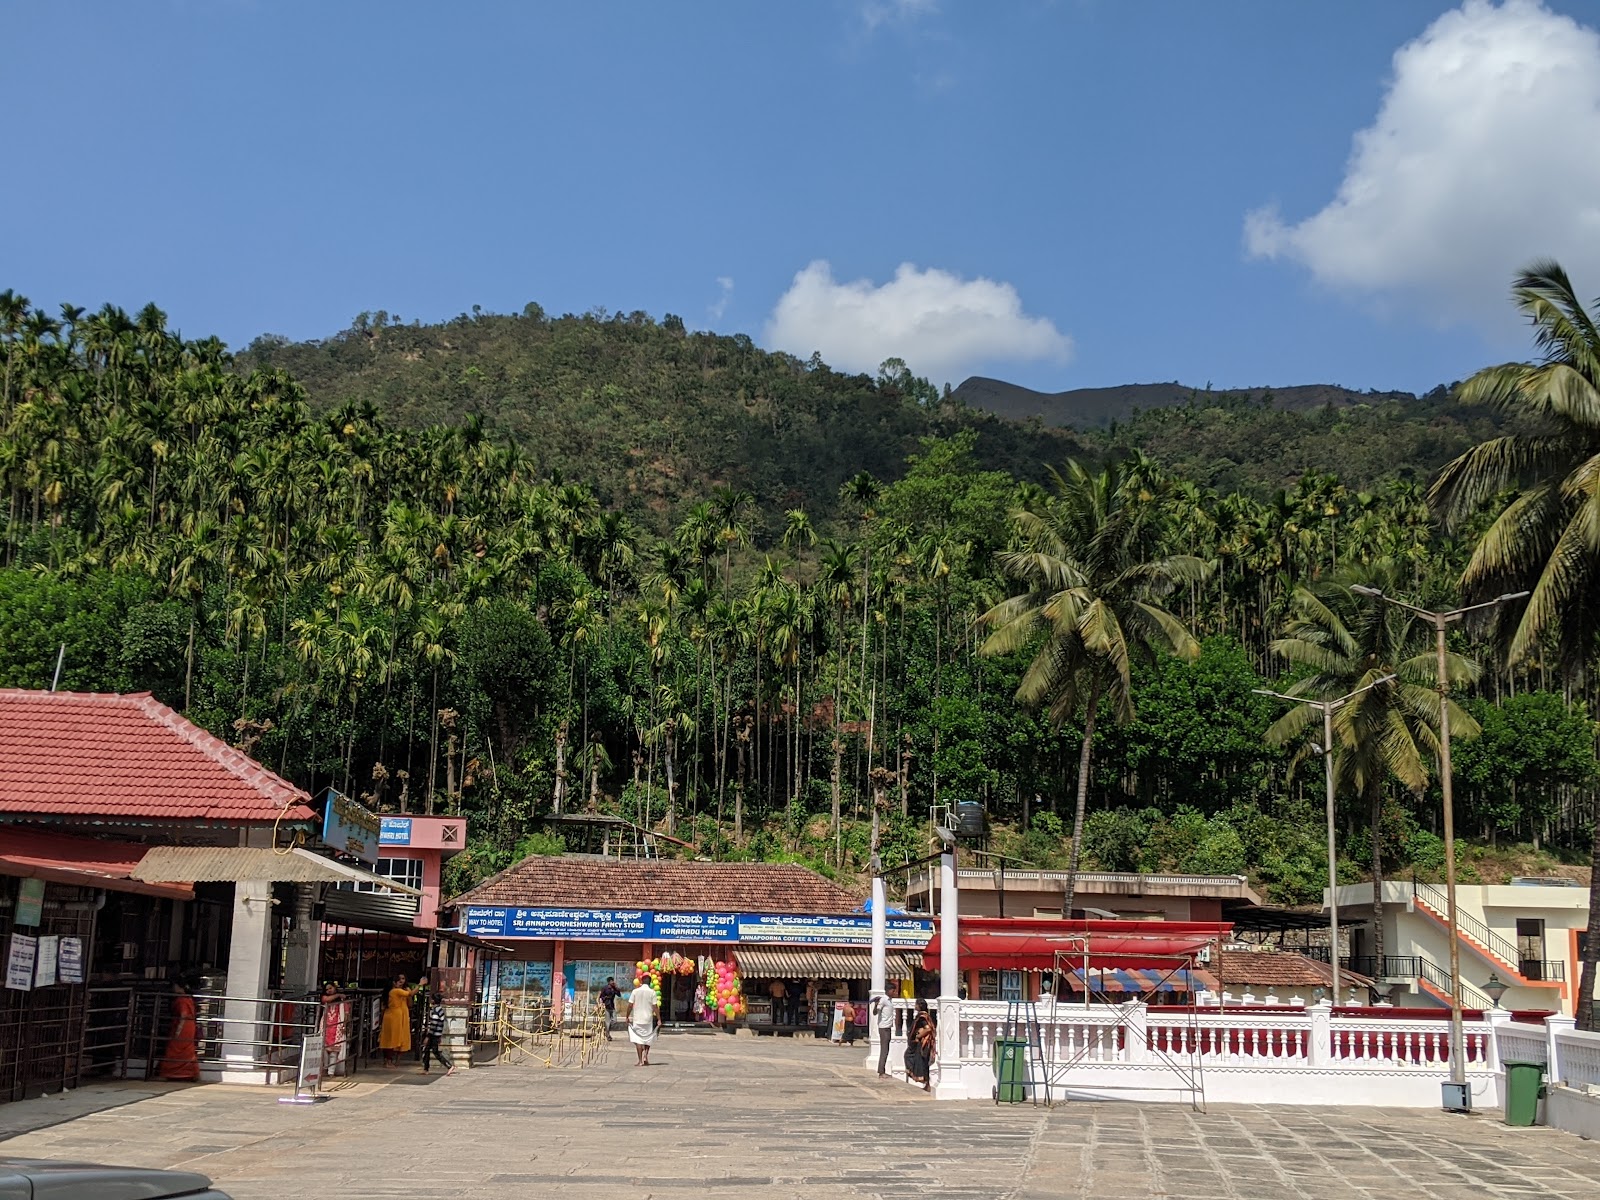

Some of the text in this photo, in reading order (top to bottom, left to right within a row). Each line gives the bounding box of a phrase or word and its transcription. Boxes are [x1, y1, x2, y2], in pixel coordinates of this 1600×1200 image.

[516, 910, 527, 919] ಶ್ರೀ
[654, 913, 735, 925] ಹೊರನಾಡು ಮಳಿಗೆ
